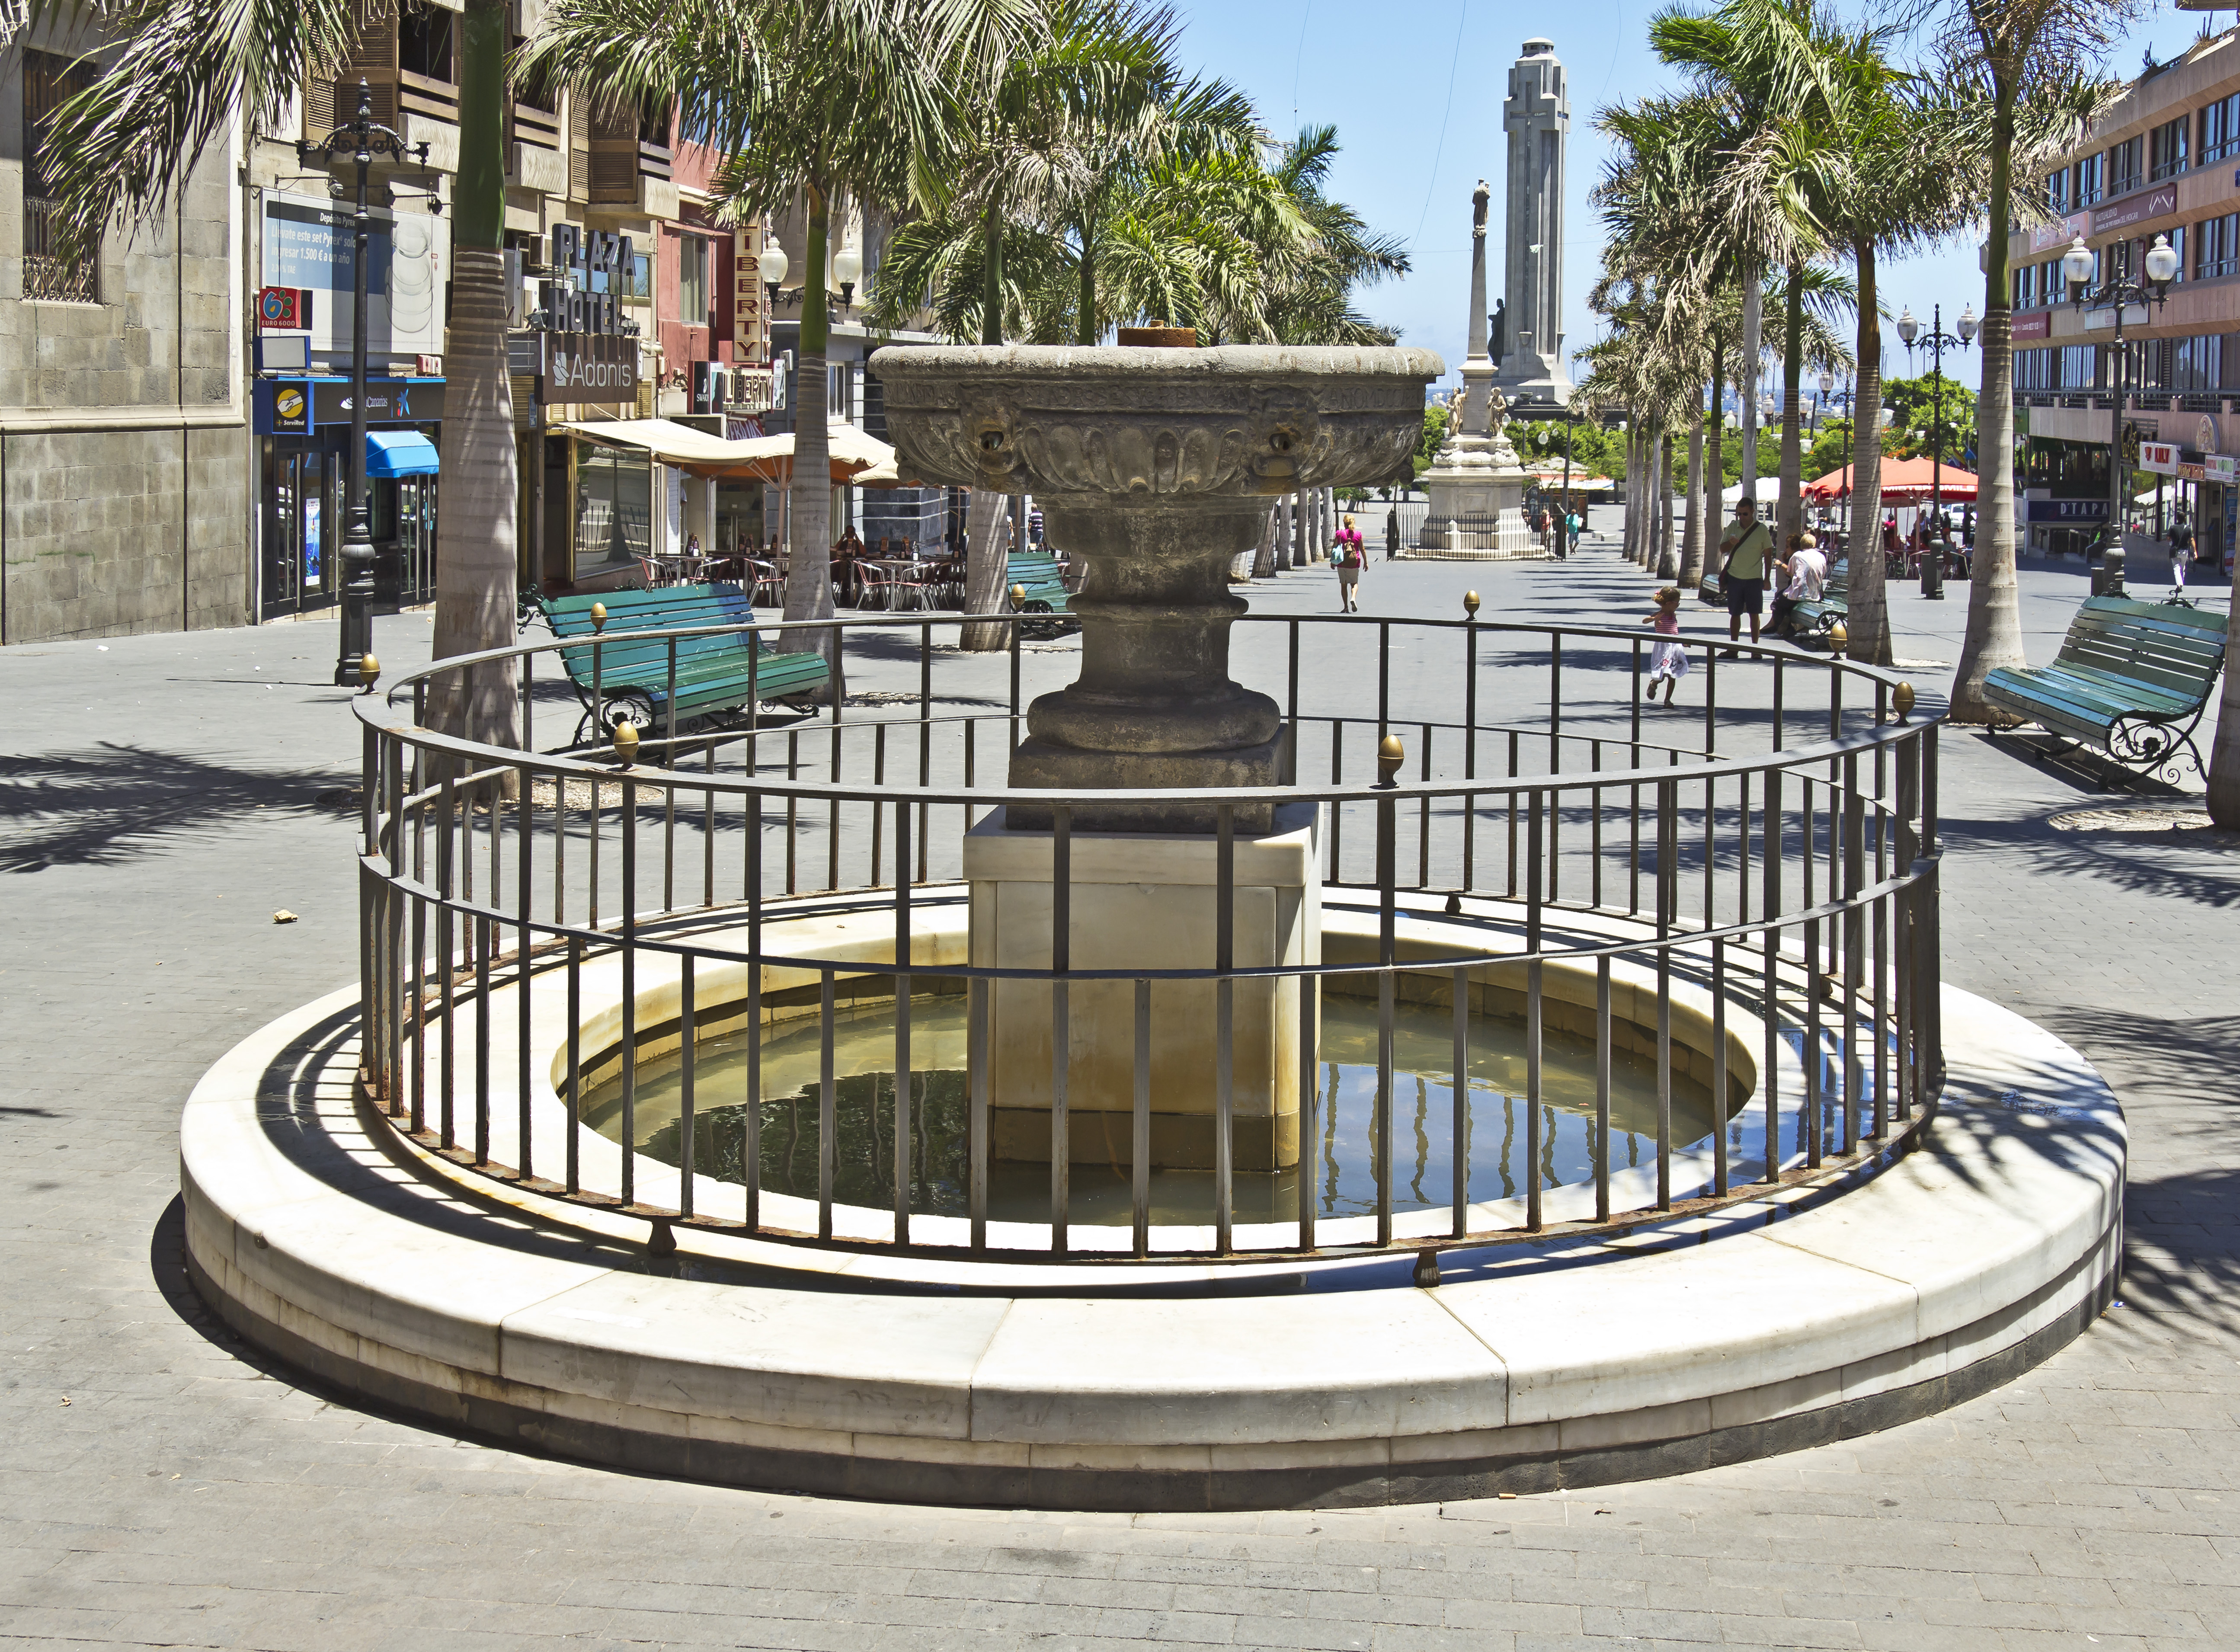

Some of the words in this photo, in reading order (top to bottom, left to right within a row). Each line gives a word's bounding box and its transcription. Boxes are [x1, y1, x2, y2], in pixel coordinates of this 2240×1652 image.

[320, 212, 342, 224] Depósito
[342, 216, 355, 227] Pyrex
[2096, 208, 2118, 222] MUTUALIDAD
[2126, 211, 2138, 222] HOGAR
[297, 230, 311, 242] este
[312, 231, 322, 243] set
[344, 236, 356, 248] solo
[300, 247, 317, 261] 1.500
[318, 250, 323, 261] €
[323, 253, 328, 262] a
[329, 253, 337, 263] un
[338, 252, 350, 265] año
[553, 223, 636, 276] PLAZA
[282, 265, 286, 273] %
[287, 265, 296, 274] TAE
[548, 287, 624, 336] HOTEL
[570, 353, 631, 387] Adonis
[723, 373, 774, 405] LIBERTY
[2061, 503, 2108, 515] D'TAPA
